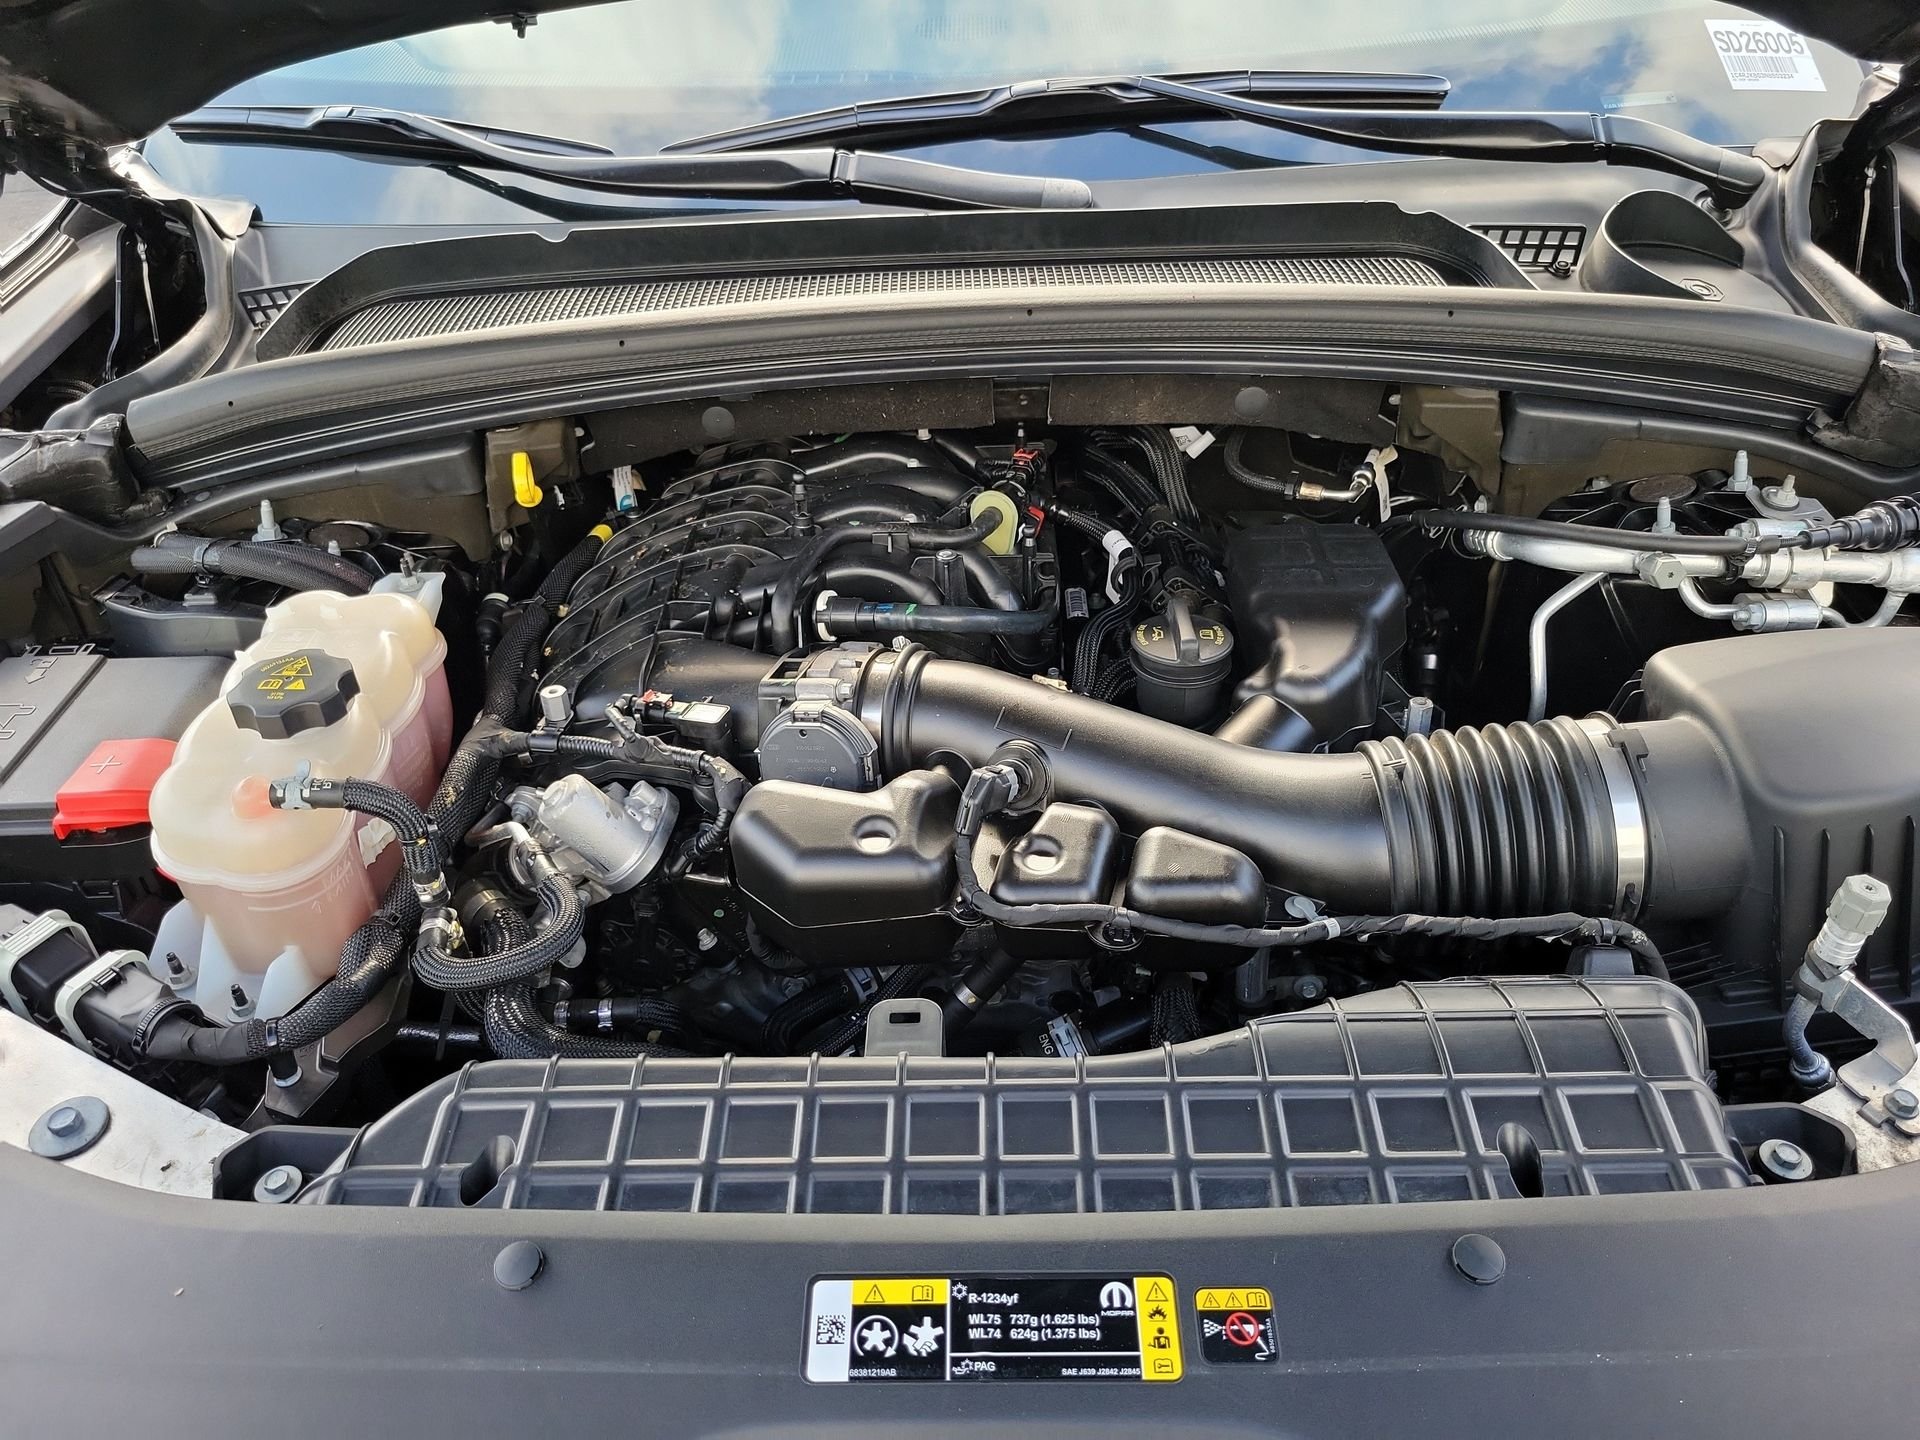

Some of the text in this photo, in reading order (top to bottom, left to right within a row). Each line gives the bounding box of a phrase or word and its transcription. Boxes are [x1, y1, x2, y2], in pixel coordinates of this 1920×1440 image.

[1713, 30, 1804, 54] SD26005
[1038, 1033, 1054, 1055] ENG
[968, 1292, 1019, 1306] R-1234yf
[968, 1313, 1100, 1327] WL75 737g (1.625 lbs)
[968, 1327, 1101, 1341] WL74 624g (1.375 lbs)
[849, 1368, 897, 1377] 68381219AB
[974, 1361, 996, 1371] PAG
